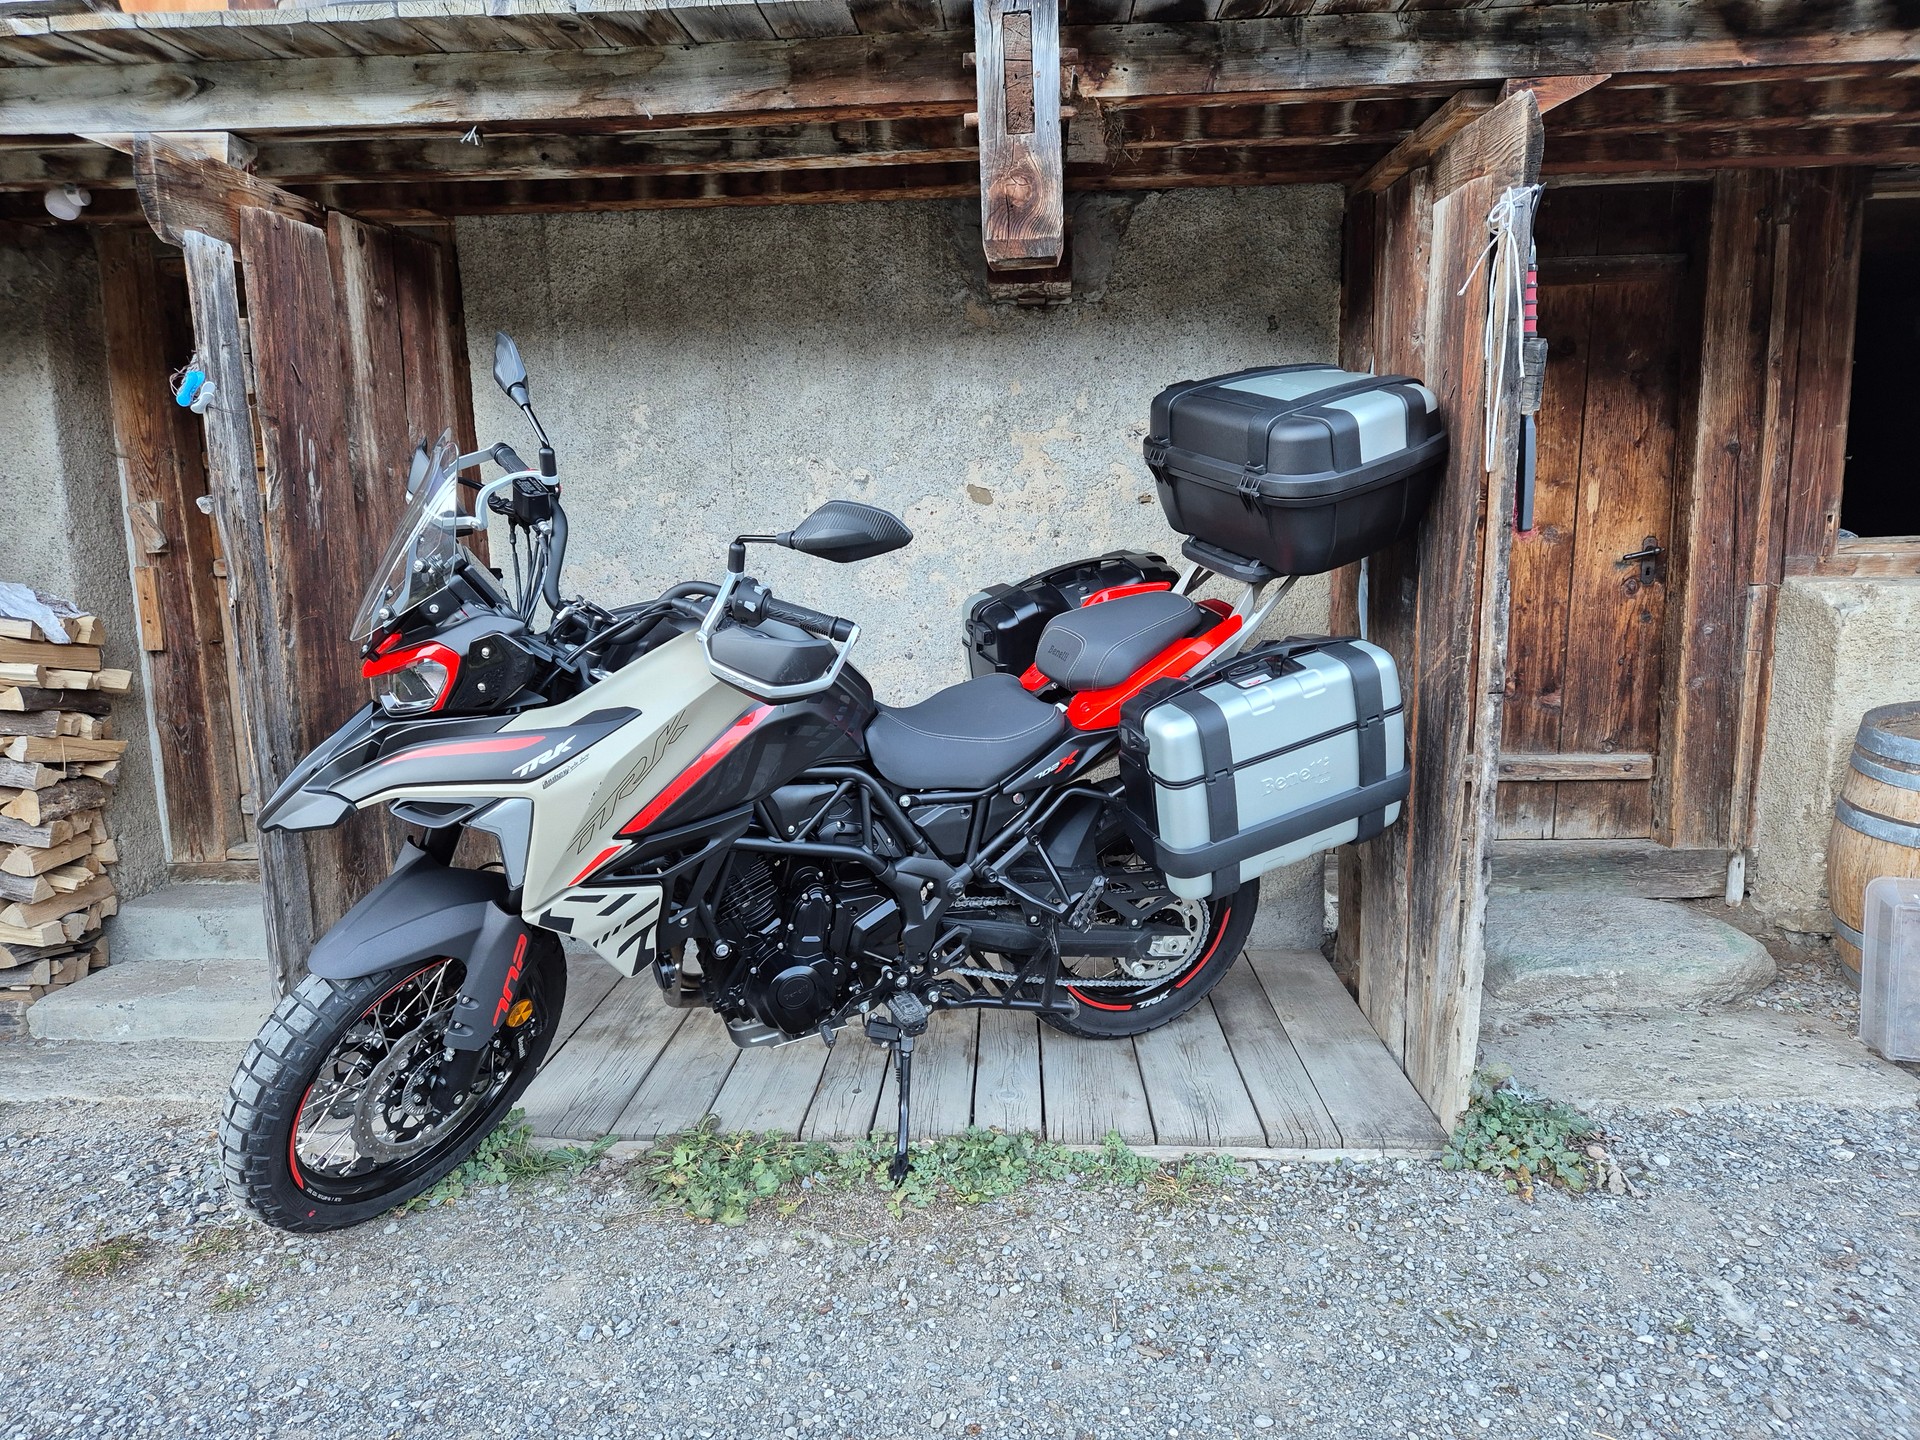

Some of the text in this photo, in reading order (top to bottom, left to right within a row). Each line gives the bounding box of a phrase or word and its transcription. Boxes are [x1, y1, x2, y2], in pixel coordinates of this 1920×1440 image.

[1048, 645, 1070, 662] Benelli
[512, 734, 577, 778] TRK
[567, 709, 689, 855] TRK
[492, 933, 527, 1027] 702
[1136, 989, 1171, 1009] TRK
